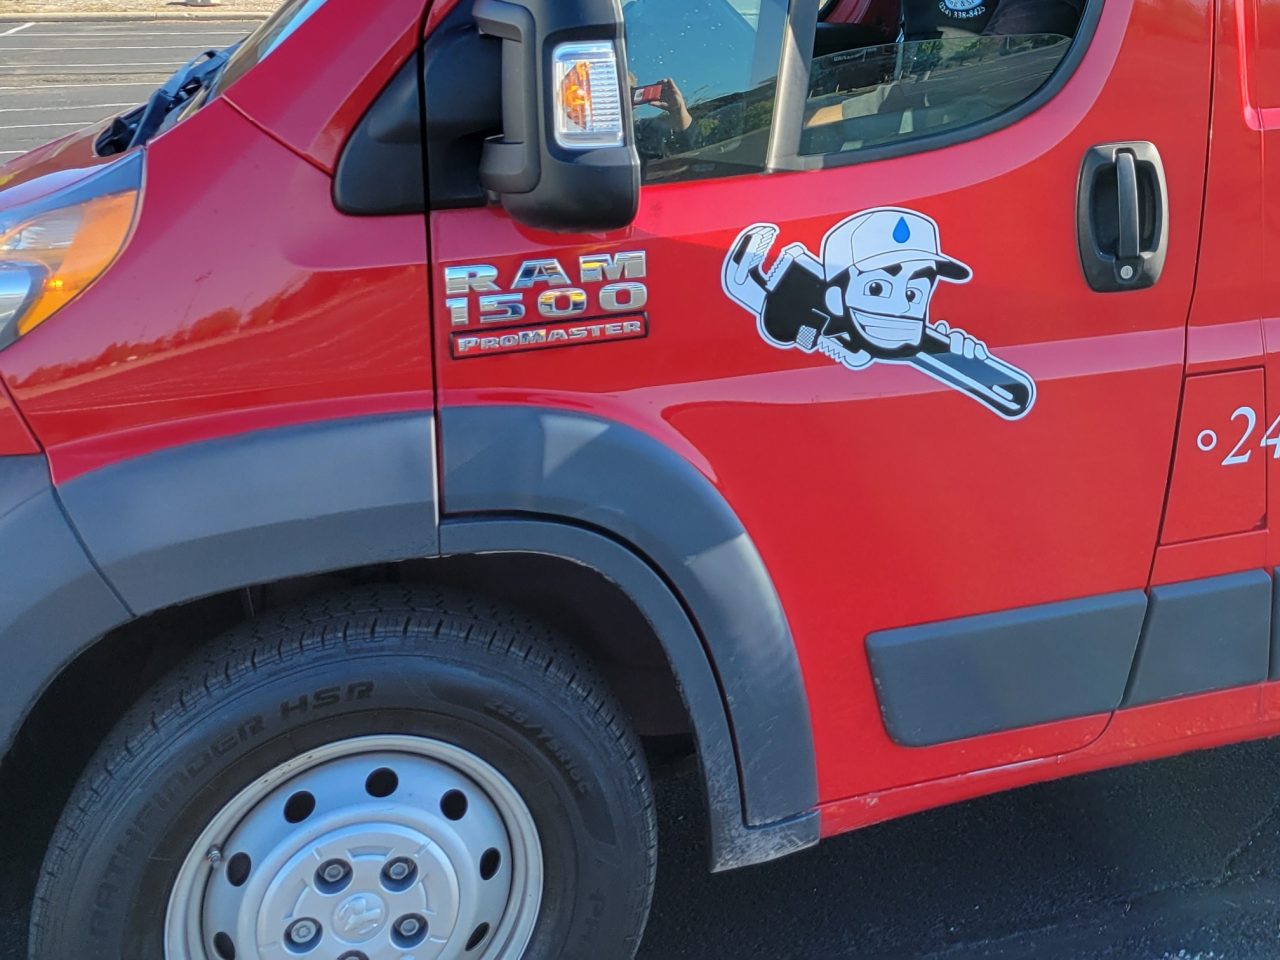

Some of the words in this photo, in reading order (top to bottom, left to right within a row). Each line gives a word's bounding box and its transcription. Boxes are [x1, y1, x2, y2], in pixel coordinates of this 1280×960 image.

[444, 250, 647, 295] RAM
[445, 282, 648, 326] 1500
[280, 679, 376, 721] HSR
